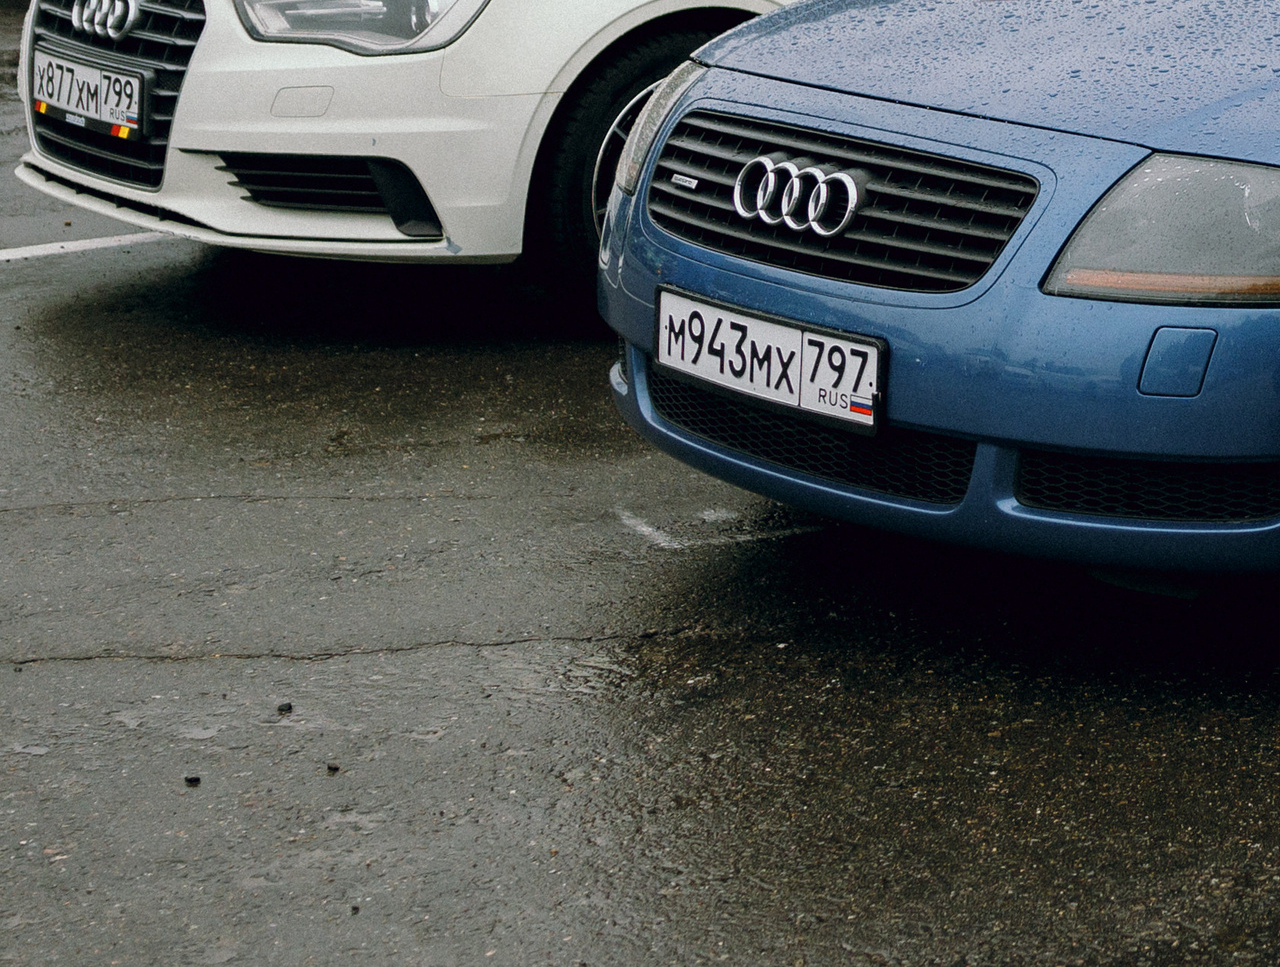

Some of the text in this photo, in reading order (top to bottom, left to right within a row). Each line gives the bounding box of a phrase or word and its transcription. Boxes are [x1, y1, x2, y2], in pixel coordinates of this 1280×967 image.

[102, 74, 134, 110] 799
[109, 107, 126, 122] RUS
[807, 338, 869, 393] 797
[818, 388, 848, 409] RUS
